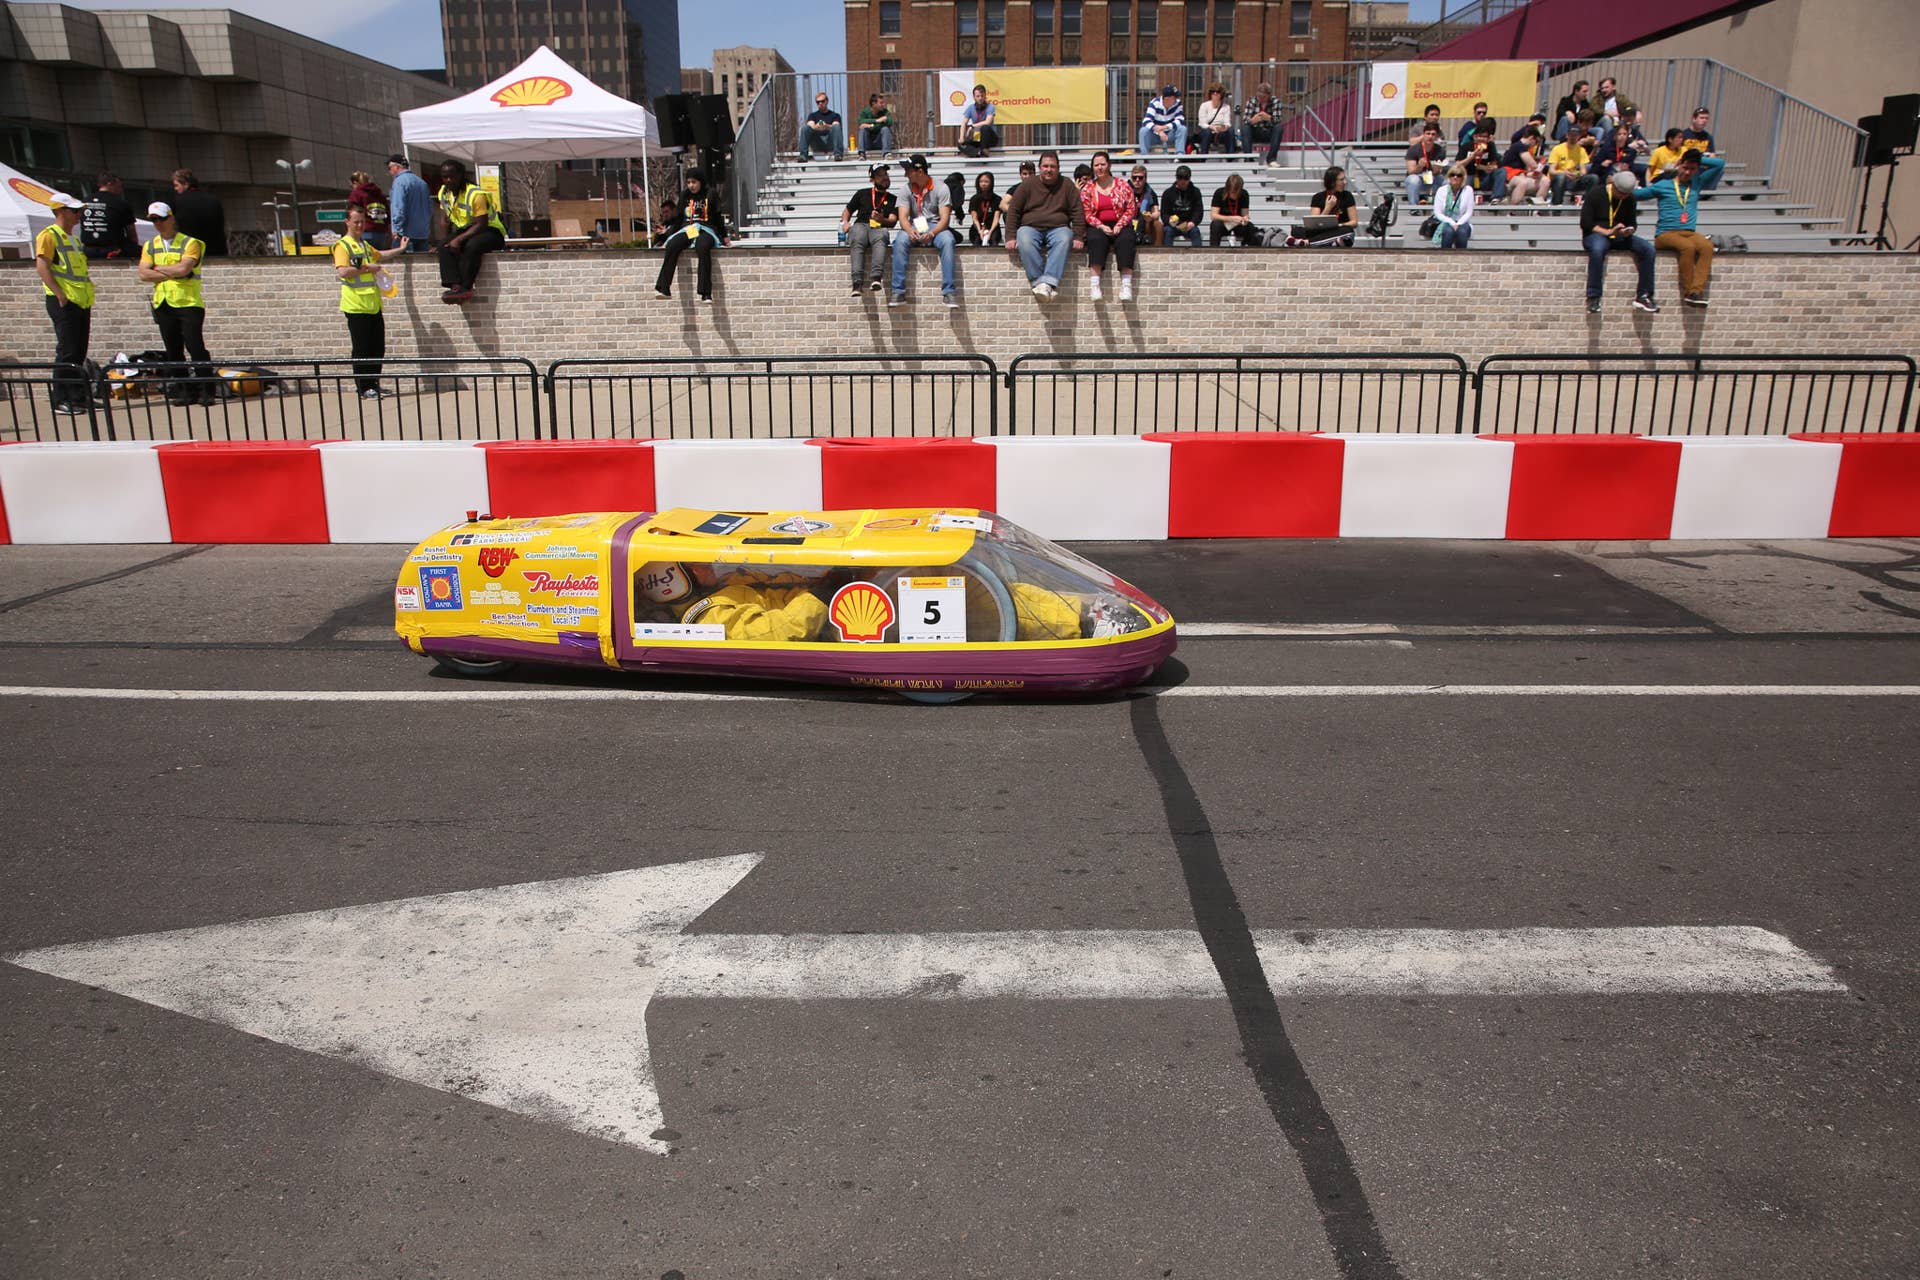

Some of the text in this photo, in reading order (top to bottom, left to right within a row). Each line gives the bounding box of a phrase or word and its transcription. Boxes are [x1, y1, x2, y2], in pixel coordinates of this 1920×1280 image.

[1414, 90, 1481, 99] Eco-marathon
[431, 554, 462, 562] Dentistry
[478, 547, 517, 572] RBW
[525, 552, 597, 560] Commercial Mowing
[397, 587, 415, 596] NSK
[527, 604, 555, 614] Plumbers
[556, 606, 567, 614] and
[923, 600, 941, 626] 5
[552, 616, 580, 625] Local 157
